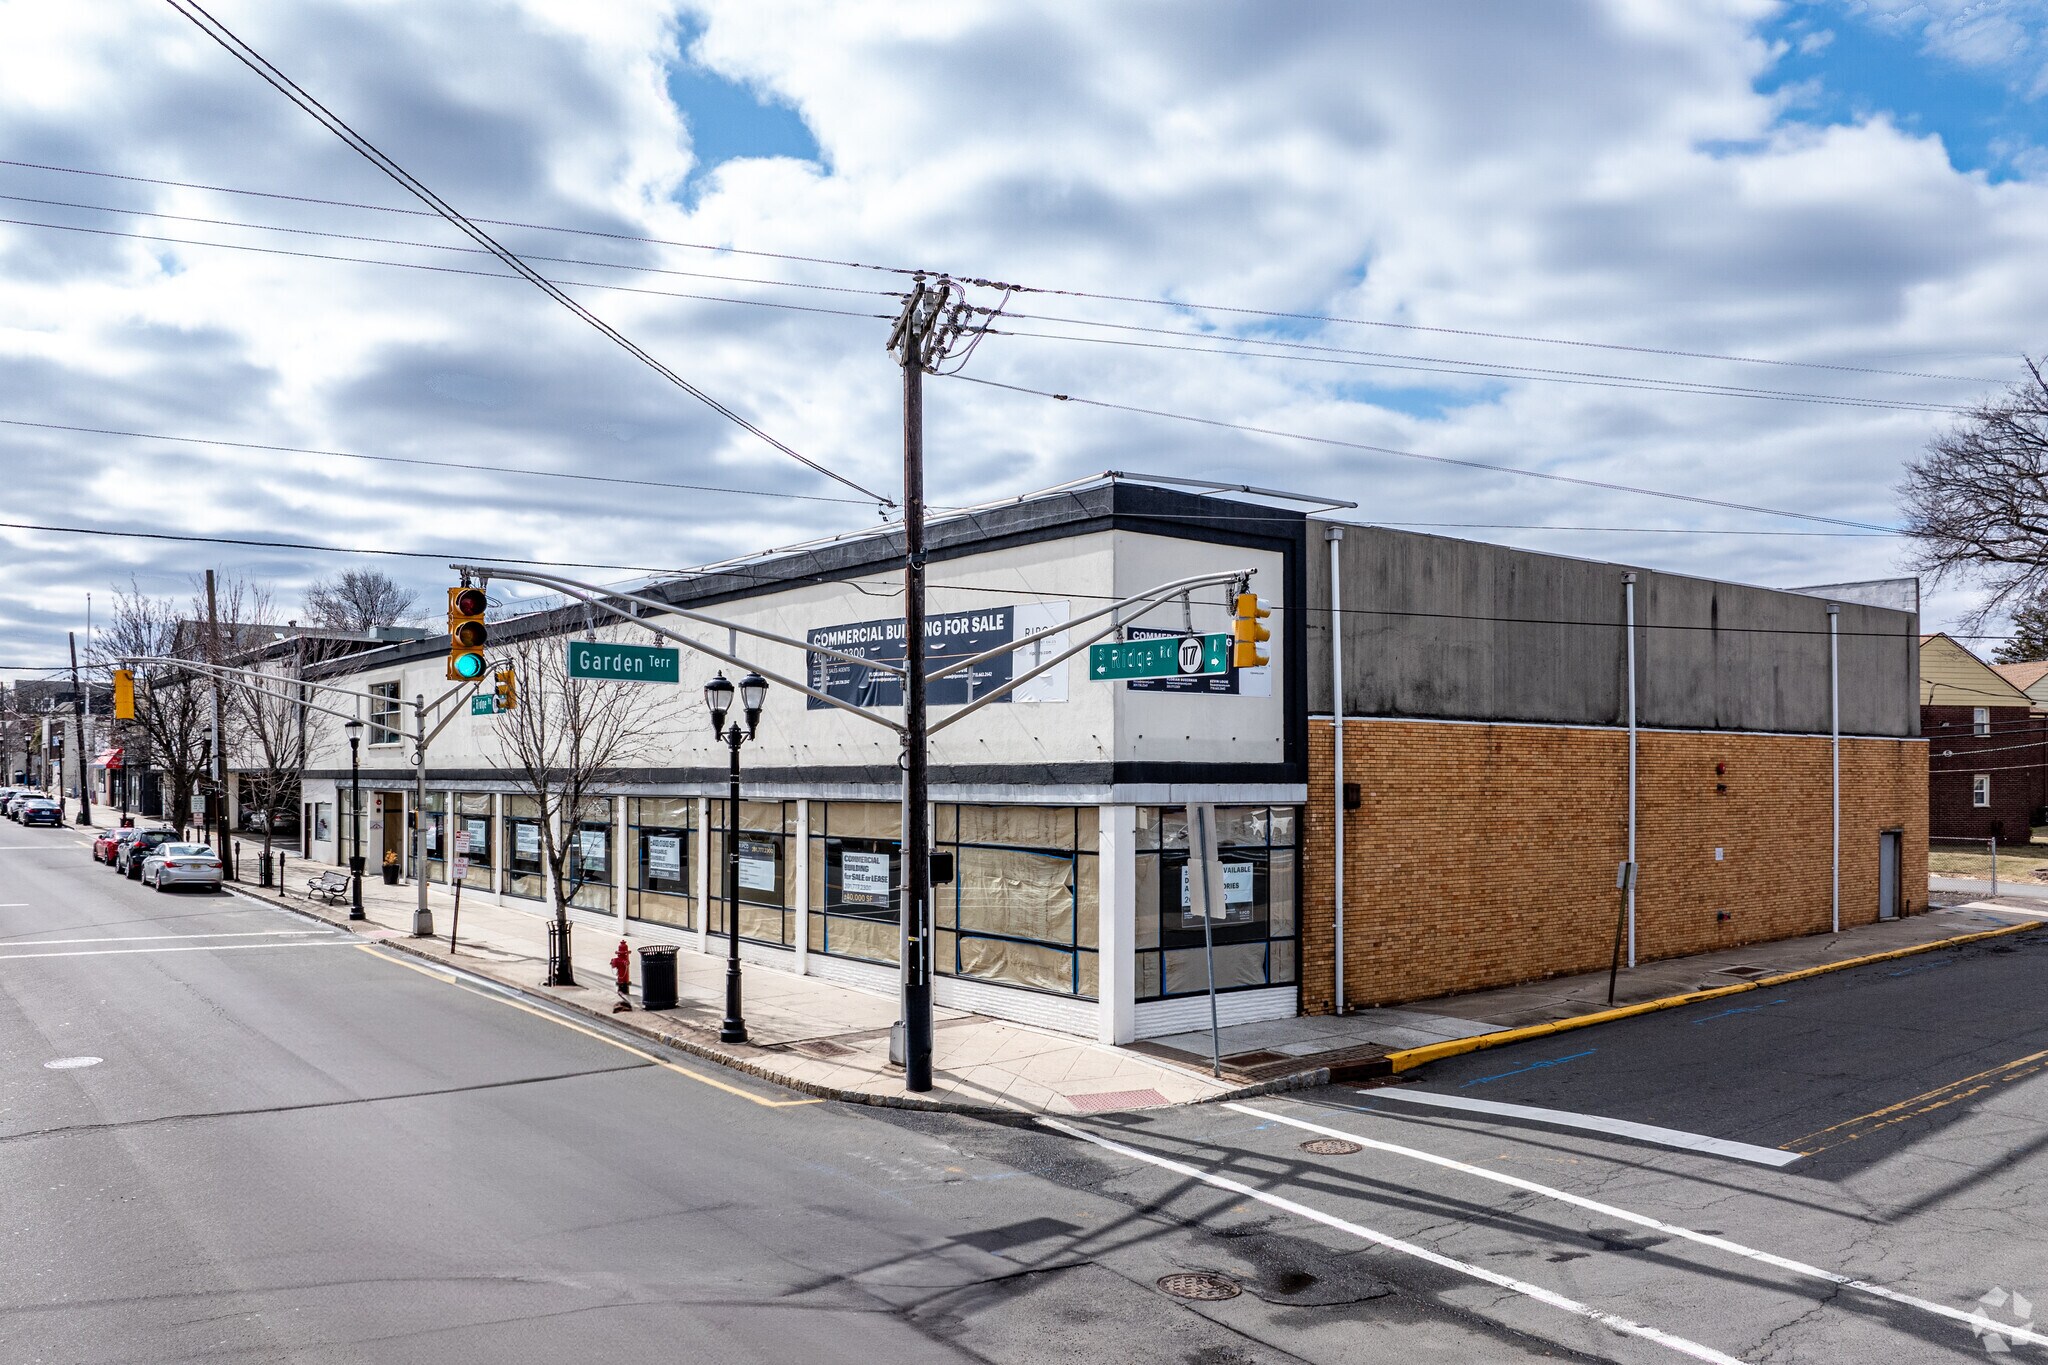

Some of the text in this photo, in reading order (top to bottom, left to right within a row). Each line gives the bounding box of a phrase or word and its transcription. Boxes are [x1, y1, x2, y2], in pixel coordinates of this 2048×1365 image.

[813, 626, 884, 647] COMMERCIAL
[944, 618, 970, 636] FOR
[971, 613, 1005, 632] SALE
[580, 650, 671, 673] Garden Terr
[1111, 648, 1154, 674] Ridge
[1160, 645, 1173, 659] Rd
[844, 855, 881, 865] COMMERCIAL
[844, 864, 870, 873] BUILDING
[1223, 866, 1251, 874] VAILABLE
[851, 873, 866, 882] SALE
[871, 875, 889, 883] LEASE
